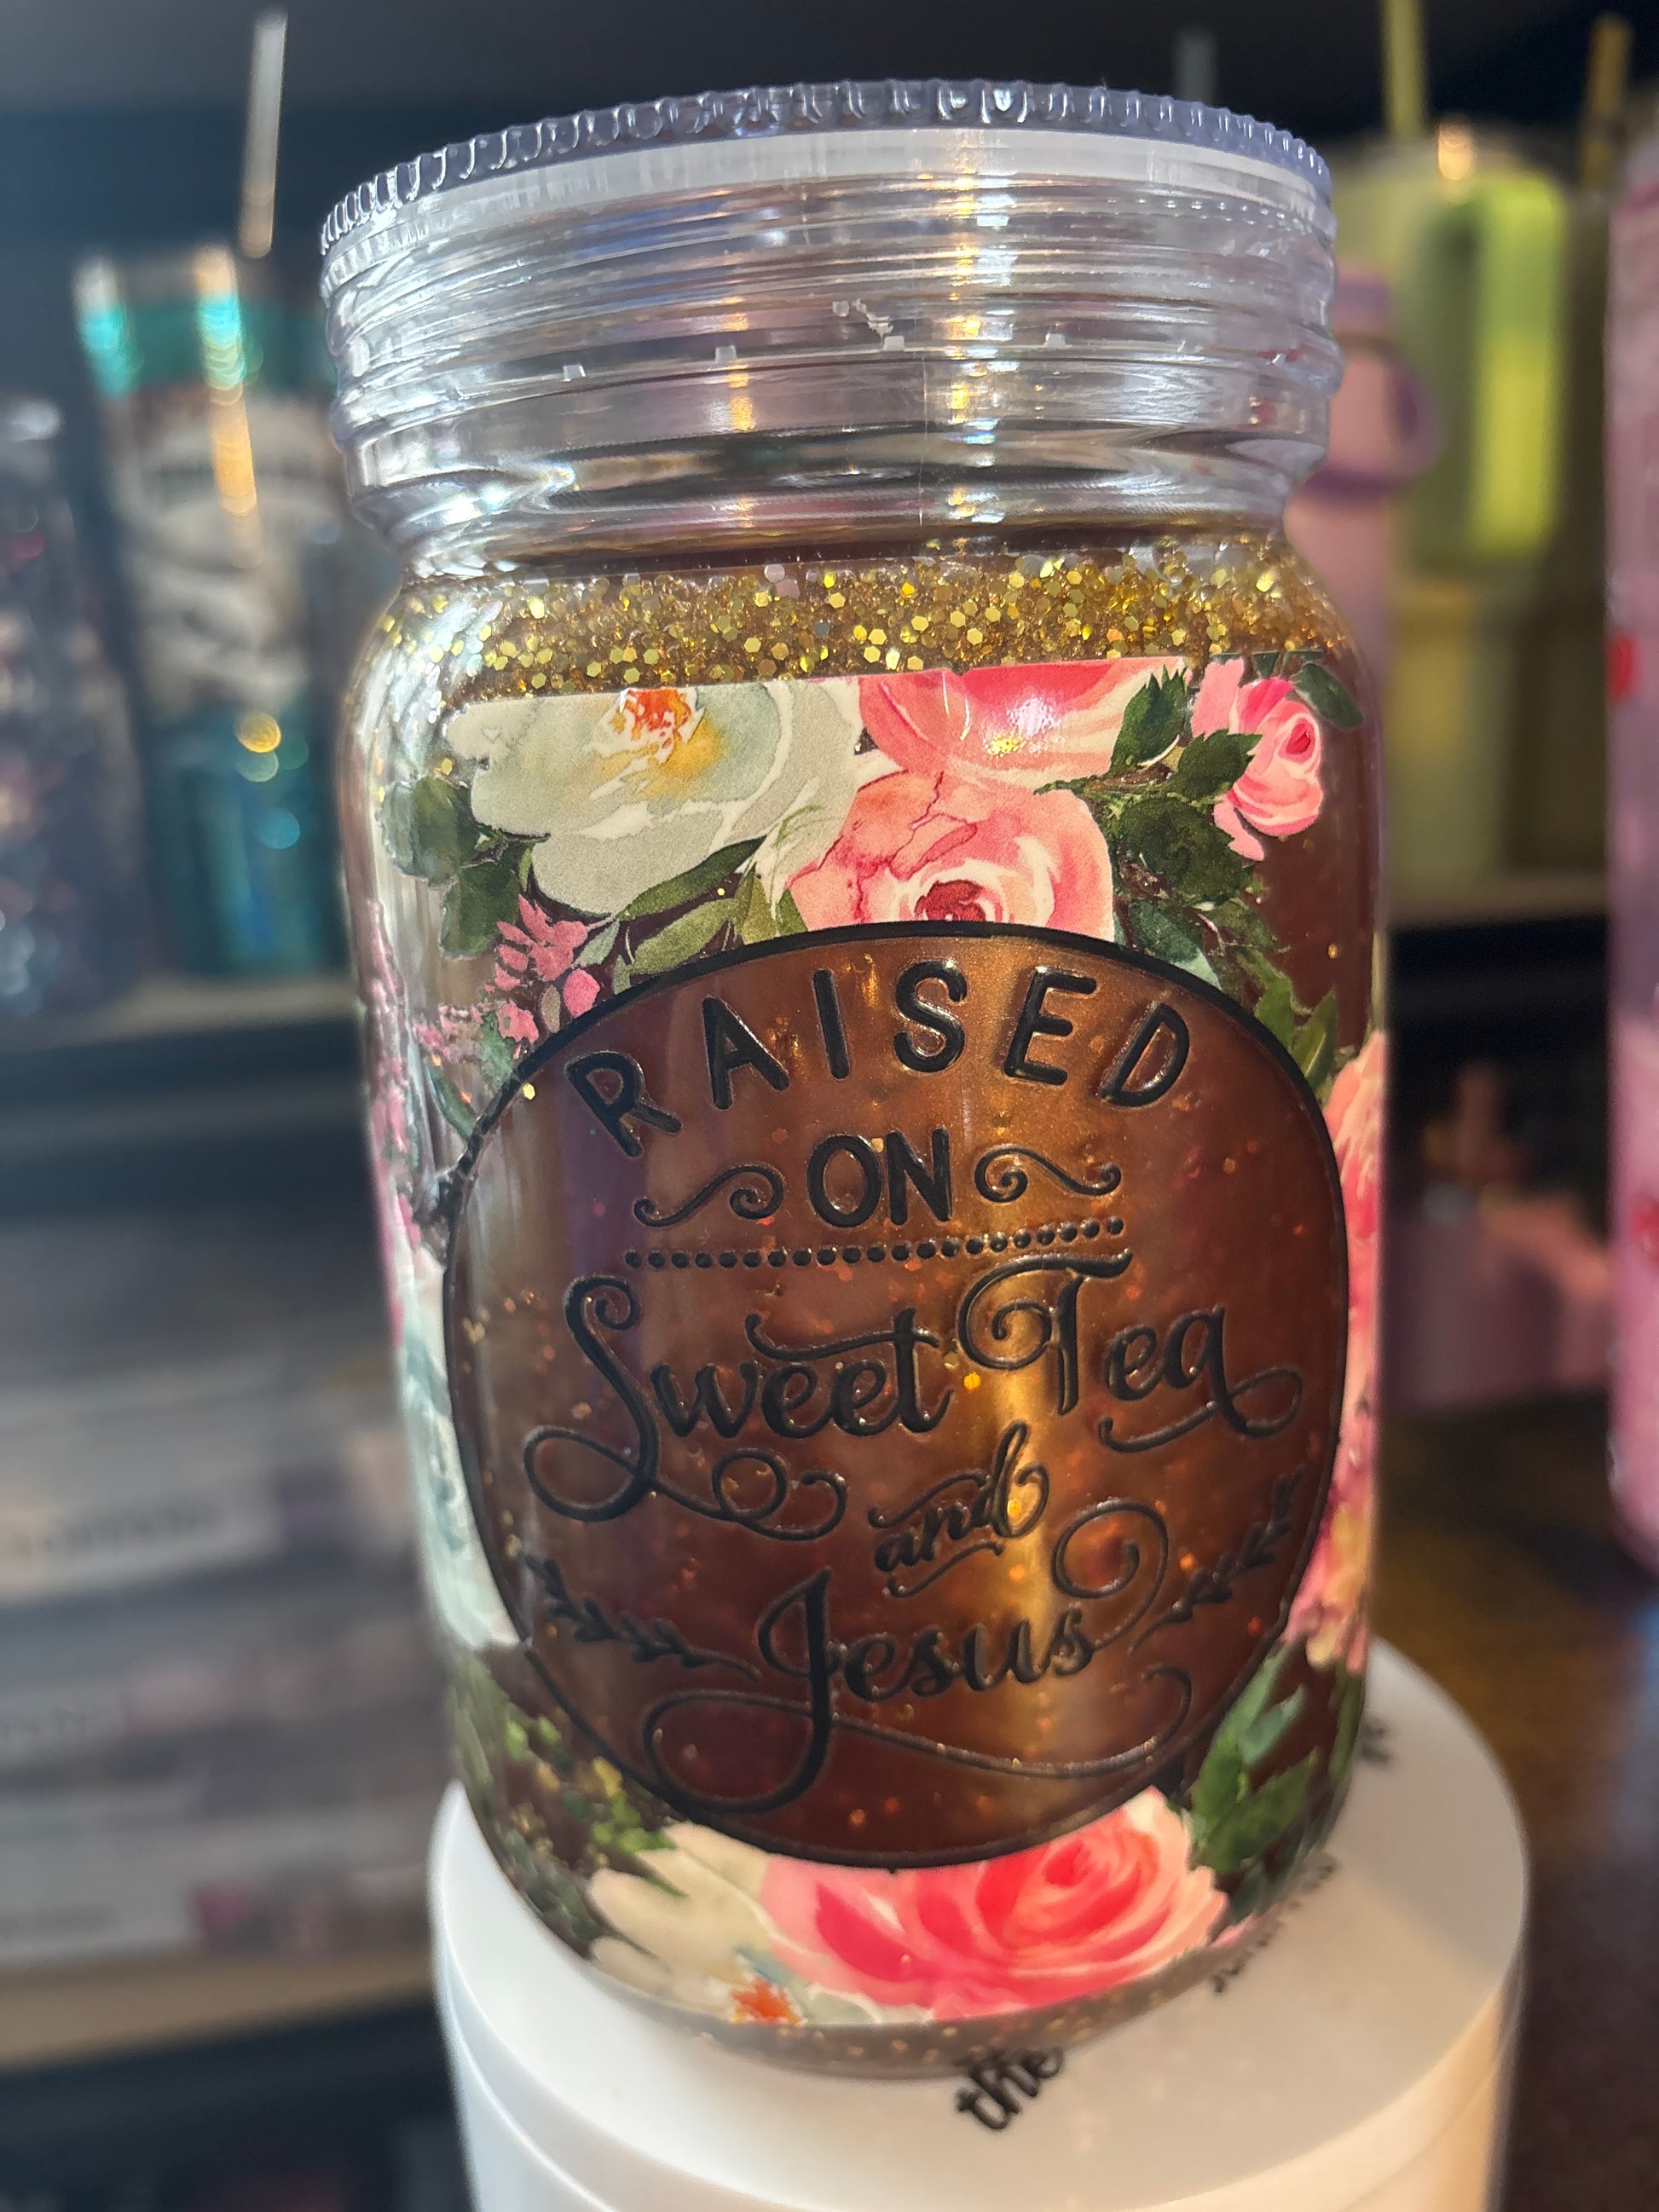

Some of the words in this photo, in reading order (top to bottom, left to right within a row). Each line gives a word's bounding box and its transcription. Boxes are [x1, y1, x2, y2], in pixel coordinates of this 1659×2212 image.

[564, 963, 1191, 1158] RAISED
[806, 1129, 955, 1228] ON
[523, 1273, 956, 1539] Sweet
[959, 1250, 1303, 1453] Tea
[869, 1422, 1049, 1598] and
[644, 1567, 1193, 1812] Jesus
[955, 2046, 1066, 2131] the
